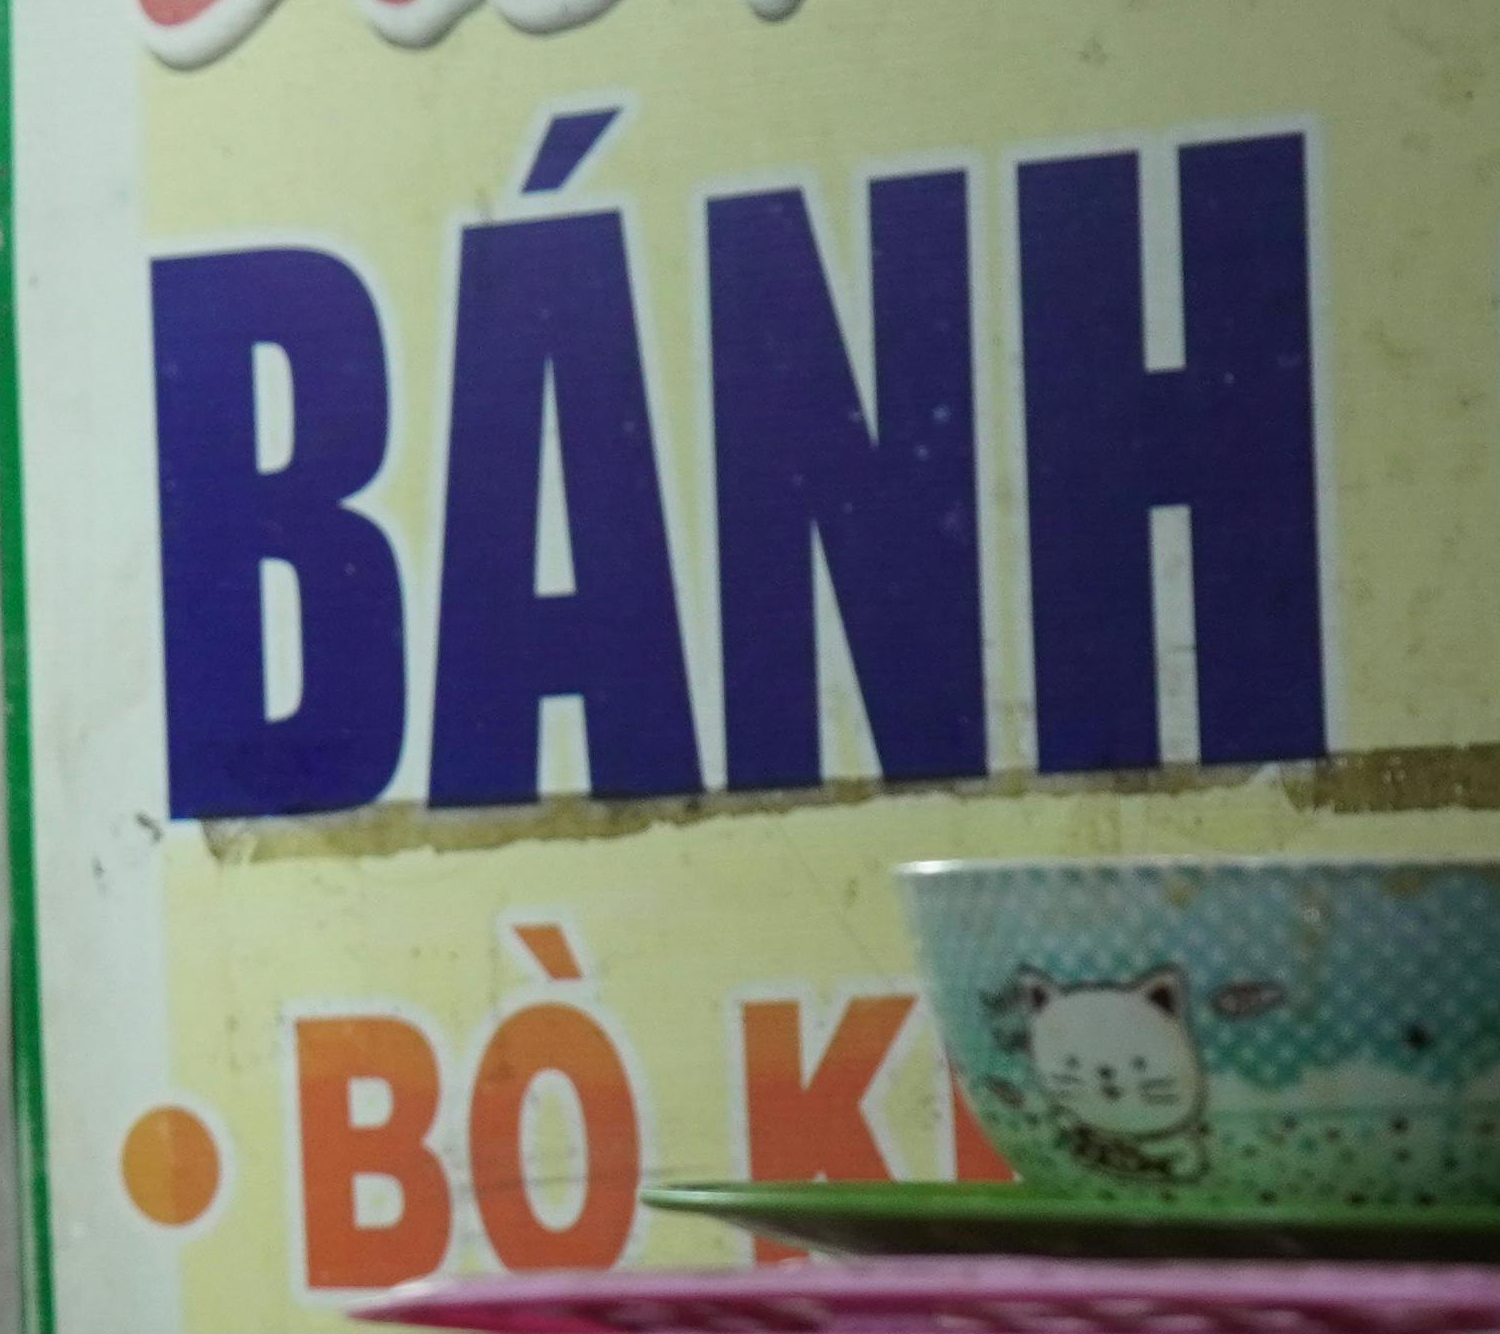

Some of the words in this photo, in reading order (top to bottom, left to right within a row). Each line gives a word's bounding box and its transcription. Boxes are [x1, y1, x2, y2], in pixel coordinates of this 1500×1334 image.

[148, 107, 1328, 823] BÁNH
[294, 923, 642, 1293] BÒ
[742, 992, 1018, 1269] K
